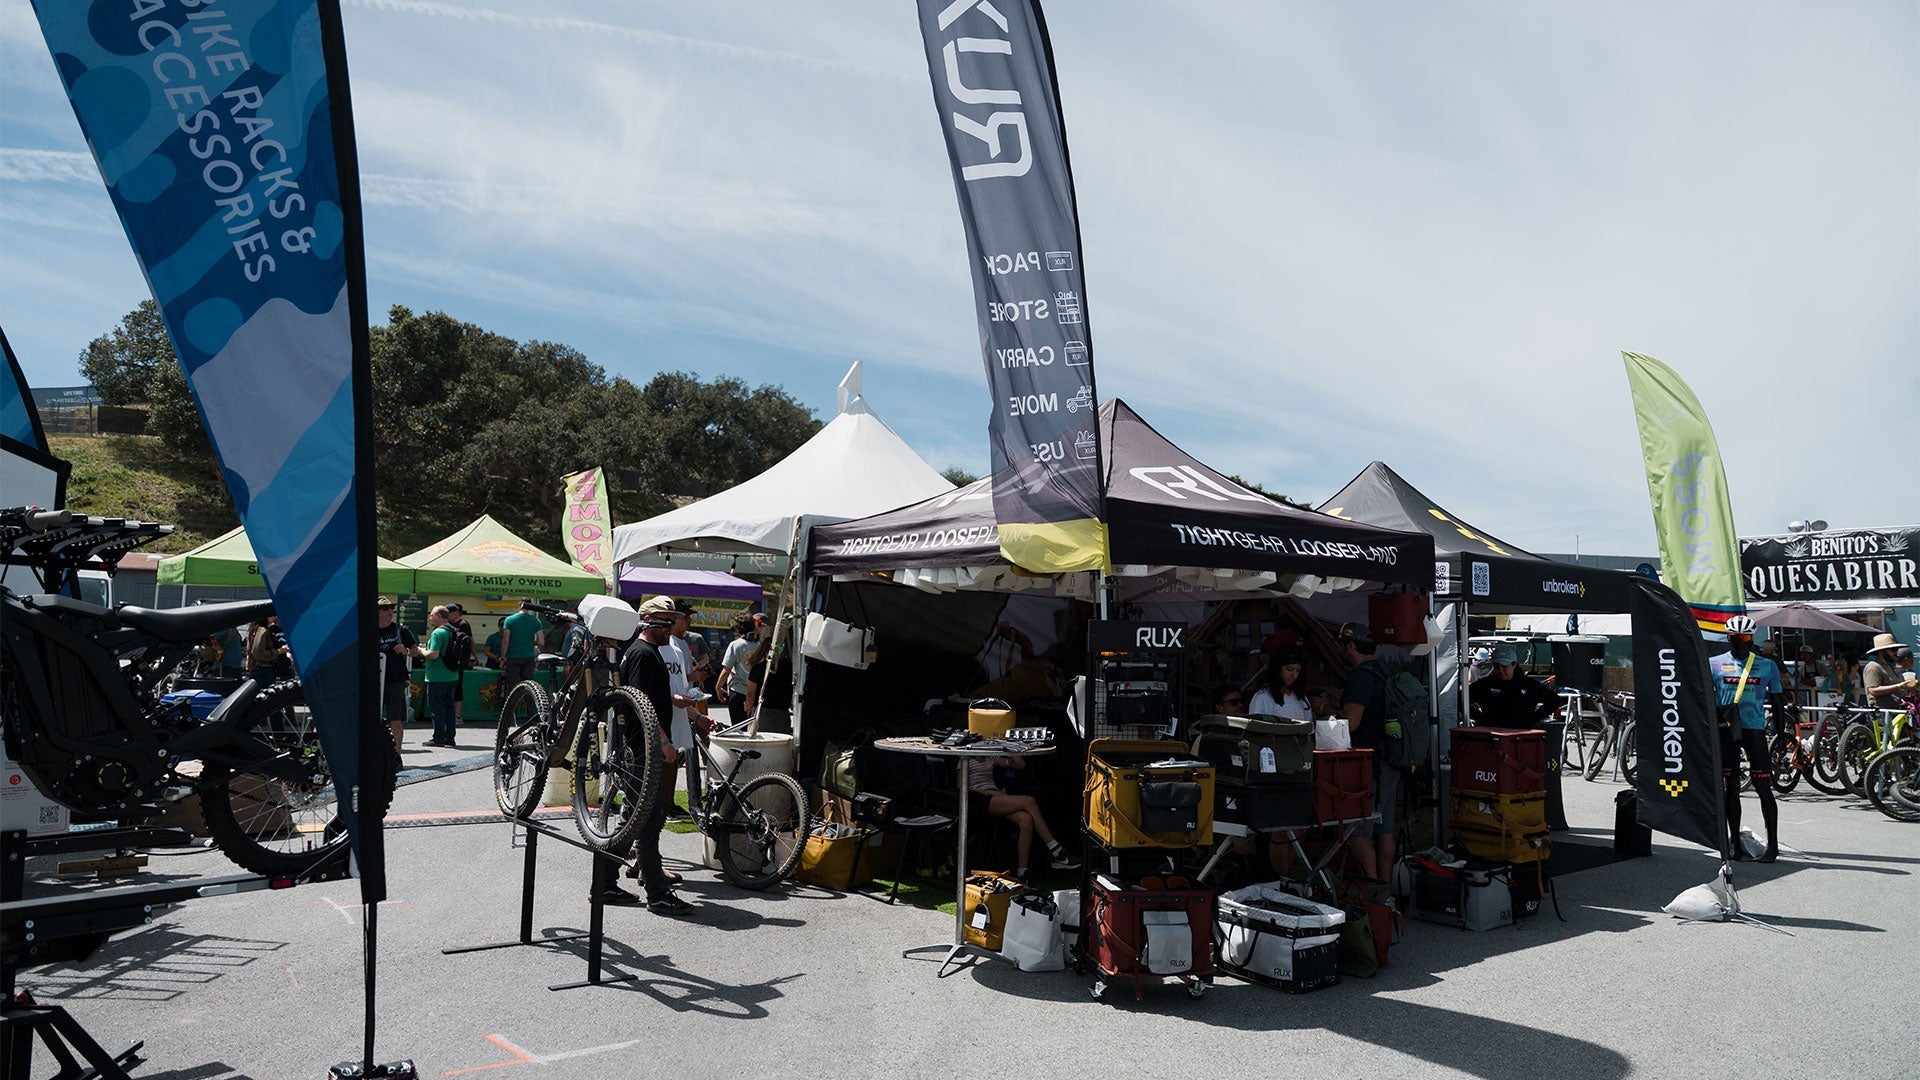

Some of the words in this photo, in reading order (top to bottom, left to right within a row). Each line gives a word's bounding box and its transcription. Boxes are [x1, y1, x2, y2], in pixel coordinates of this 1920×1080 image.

[182, 0, 250, 76] IKE
[222, 86, 305, 218] RACKS
[281, 227, 316, 255] &
[129, 0, 276, 282] ACCESSORIES
[1671, 453, 1712, 574] MOSS
[838, 533, 919, 556] TIGHTGEAR
[1171, 523, 1289, 554] TIGHTGEAR
[1811, 536, 1879, 557] BENITO'S
[465, 575, 514, 586] FAMILY
[519, 577, 562, 588] OWNED
[1542, 579, 1580, 594] unbroken
[1750, 558, 1920, 598] QUESABIRR
[1136, 627, 1185, 648] RUX
[1658, 648, 1685, 774] unbroken
[1475, 770, 1497, 783] RUX
[1170, 959, 1186, 968] RUX
[1273, 967, 1292, 978] RUX
